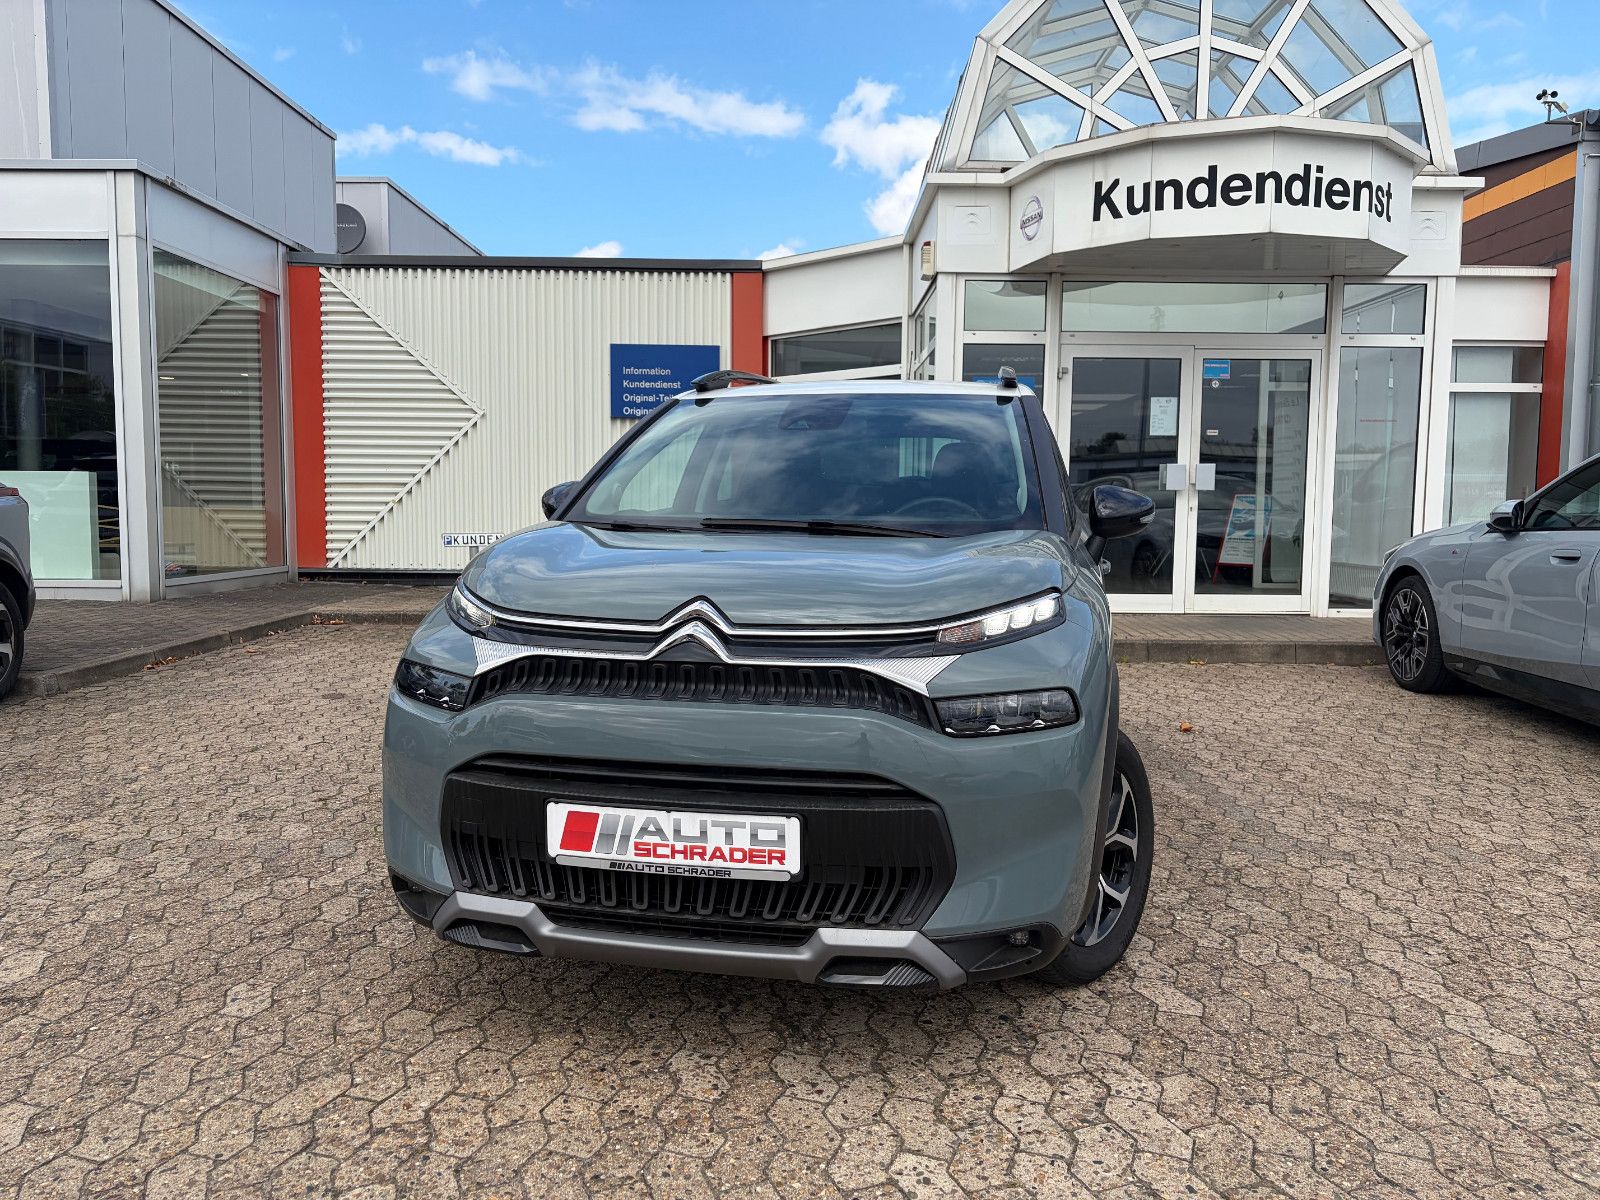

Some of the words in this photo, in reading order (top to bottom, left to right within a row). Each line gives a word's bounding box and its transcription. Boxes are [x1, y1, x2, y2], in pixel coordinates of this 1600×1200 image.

[1092, 163, 1393, 223] Kundendienst
[1021, 210, 1042, 226] NISSAN
[623, 367, 671, 376] Information
[622, 380, 681, 389] Kundendienst
[623, 407, 655, 416] Origin
[634, 816, 786, 847] AUTO
[634, 841, 786, 865] SCHRADER
[625, 863, 665, 873] AUTO
[667, 866, 732, 877] SCHRADER
